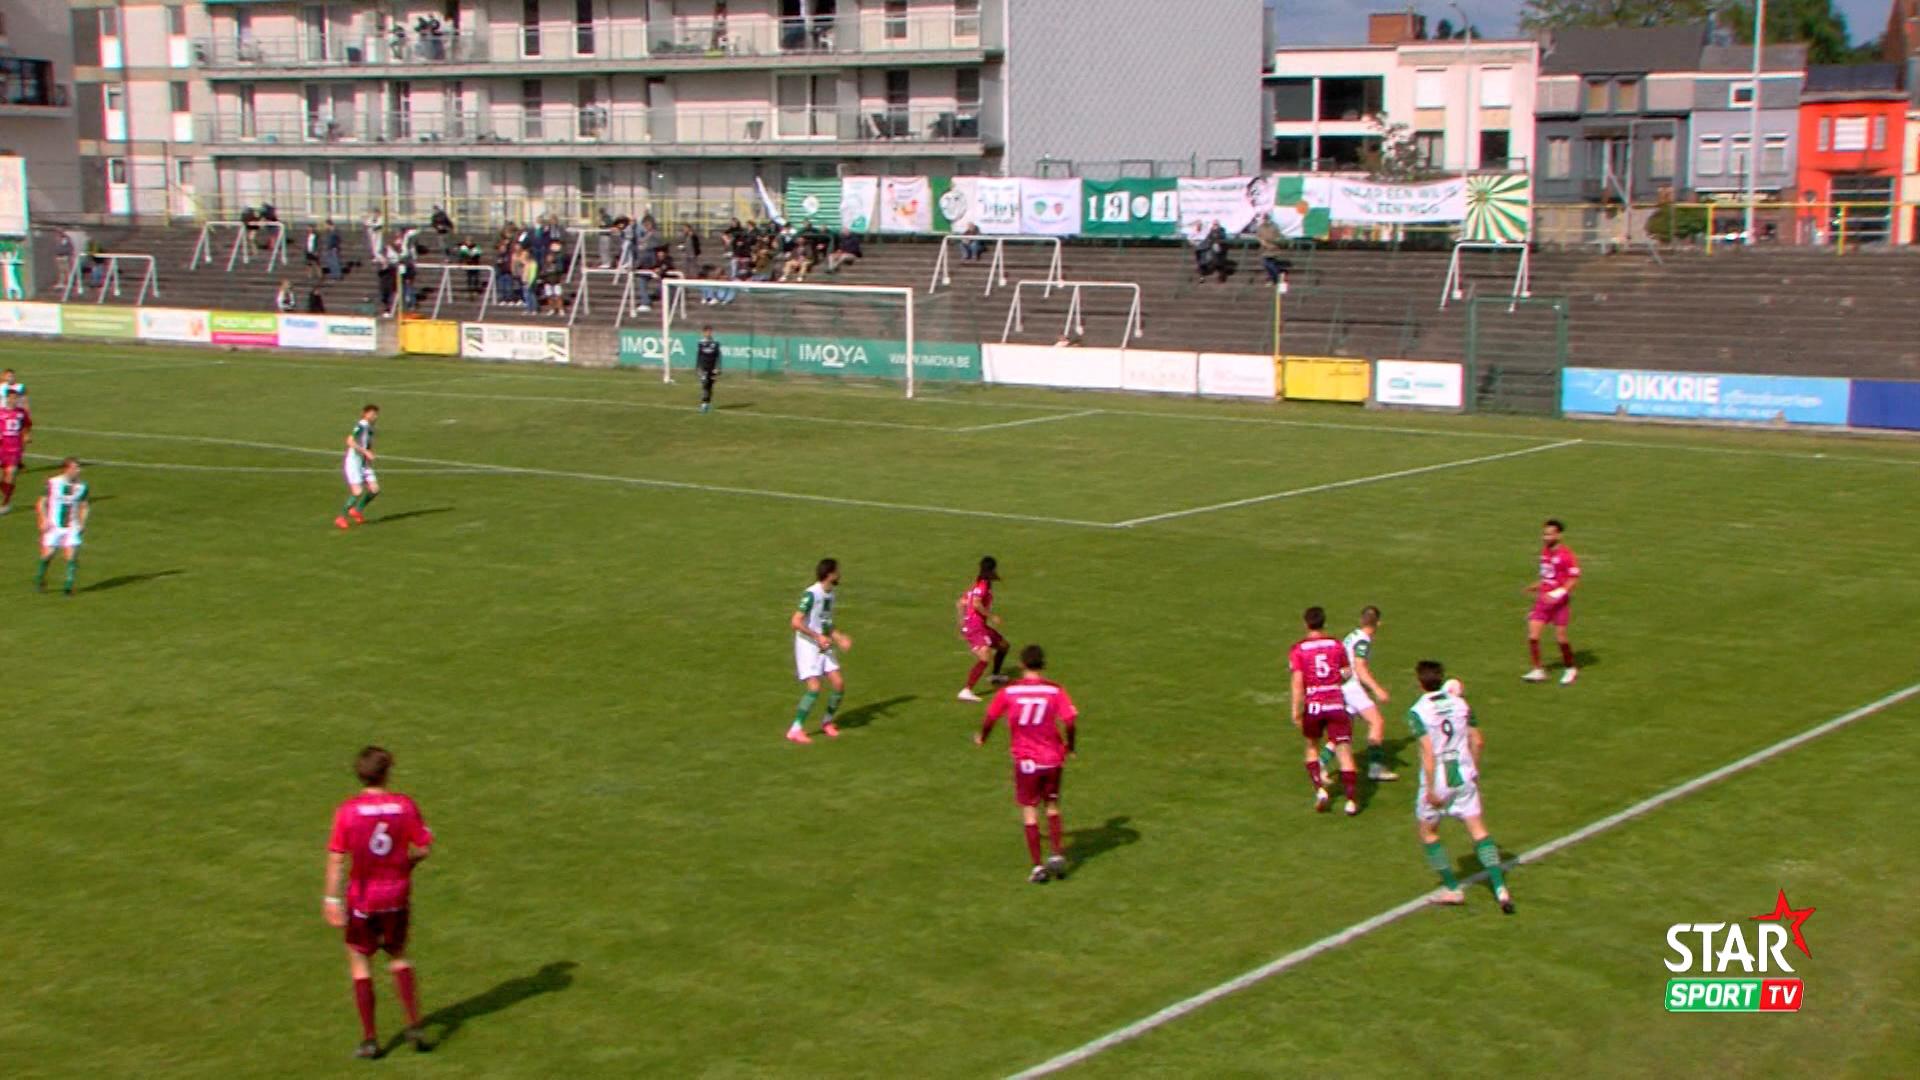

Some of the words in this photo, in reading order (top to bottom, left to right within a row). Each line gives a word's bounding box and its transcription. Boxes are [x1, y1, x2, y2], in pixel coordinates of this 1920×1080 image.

[799, 343, 868, 367] IMOYA
[1617, 373, 1720, 404] DIKKRIE
[1314, 654, 1330, 678] 5
[1016, 698, 1049, 726] 77
[1441, 719, 1454, 743] 9
[368, 822, 393, 856] 6
